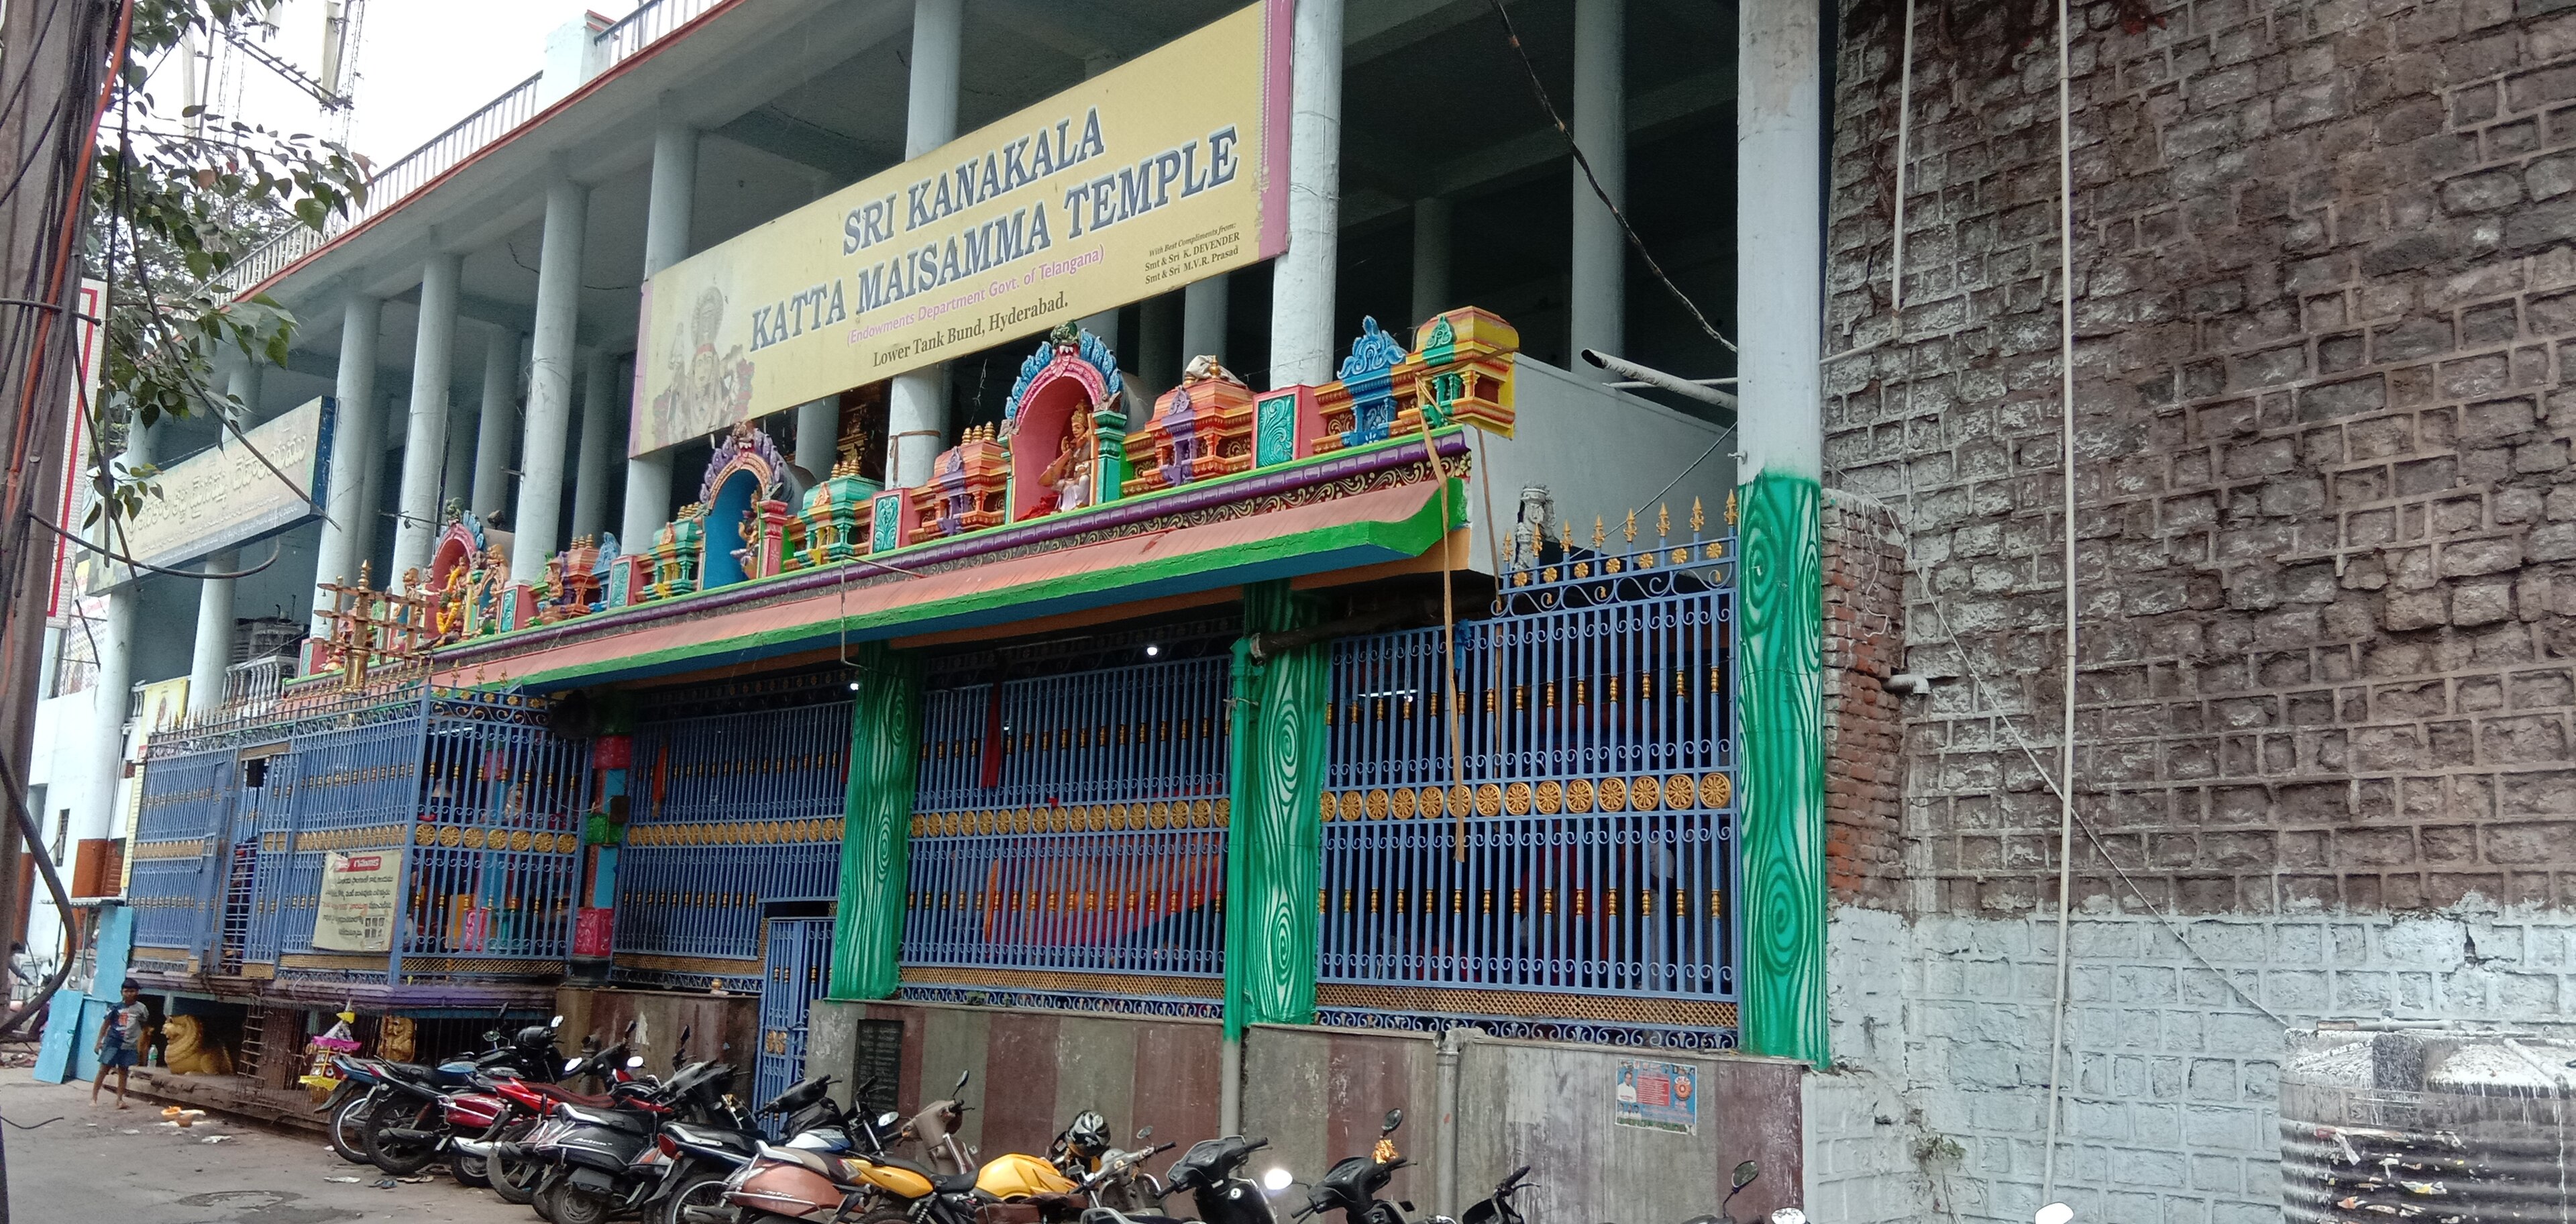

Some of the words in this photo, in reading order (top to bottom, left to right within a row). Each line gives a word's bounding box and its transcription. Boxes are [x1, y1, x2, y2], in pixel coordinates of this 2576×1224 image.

[843, 193, 898, 256] SRI
[906, 106, 1105, 232] KANAKALA
[749, 277, 847, 352] KATTA
[856, 201, 1051, 315] MAISAMMA
[1063, 125, 1239, 240] TEMPLE
[1144, 258, 1160, 272] Smt
[1161, 257, 1168, 266] &
[1169, 253, 1180, 264] Sri
[1183, 248, 1192, 259] K.
[1193, 232, 1240, 256] DEVENDER
[1144, 272, 1161, 285] Smt
[1161, 270, 1168, 279] &
[1169, 265, 1181, 276] Sri
[1183, 256, 1210, 272] M.V.R.
[1212, 245, 1239, 263] Prasad
[1148, 246, 1164, 258] With
[1165, 242, 1177, 253] Best
[1178, 229, 1218, 248] Compliments
[1217, 223, 1237, 236] from:
[847, 313, 915, 348] (Endowments
[918, 289, 986, 321] Department
[989, 277, 1020, 299] Govt.
[1024, 268, 1037, 286] of
[1039, 244, 1106, 280] Telangana)
[873, 345, 911, 368] Lower
[913, 332, 945, 354] Tank
[947, 319, 985, 345] Bund,
[989, 291, 1069, 333] Hyderabad.
